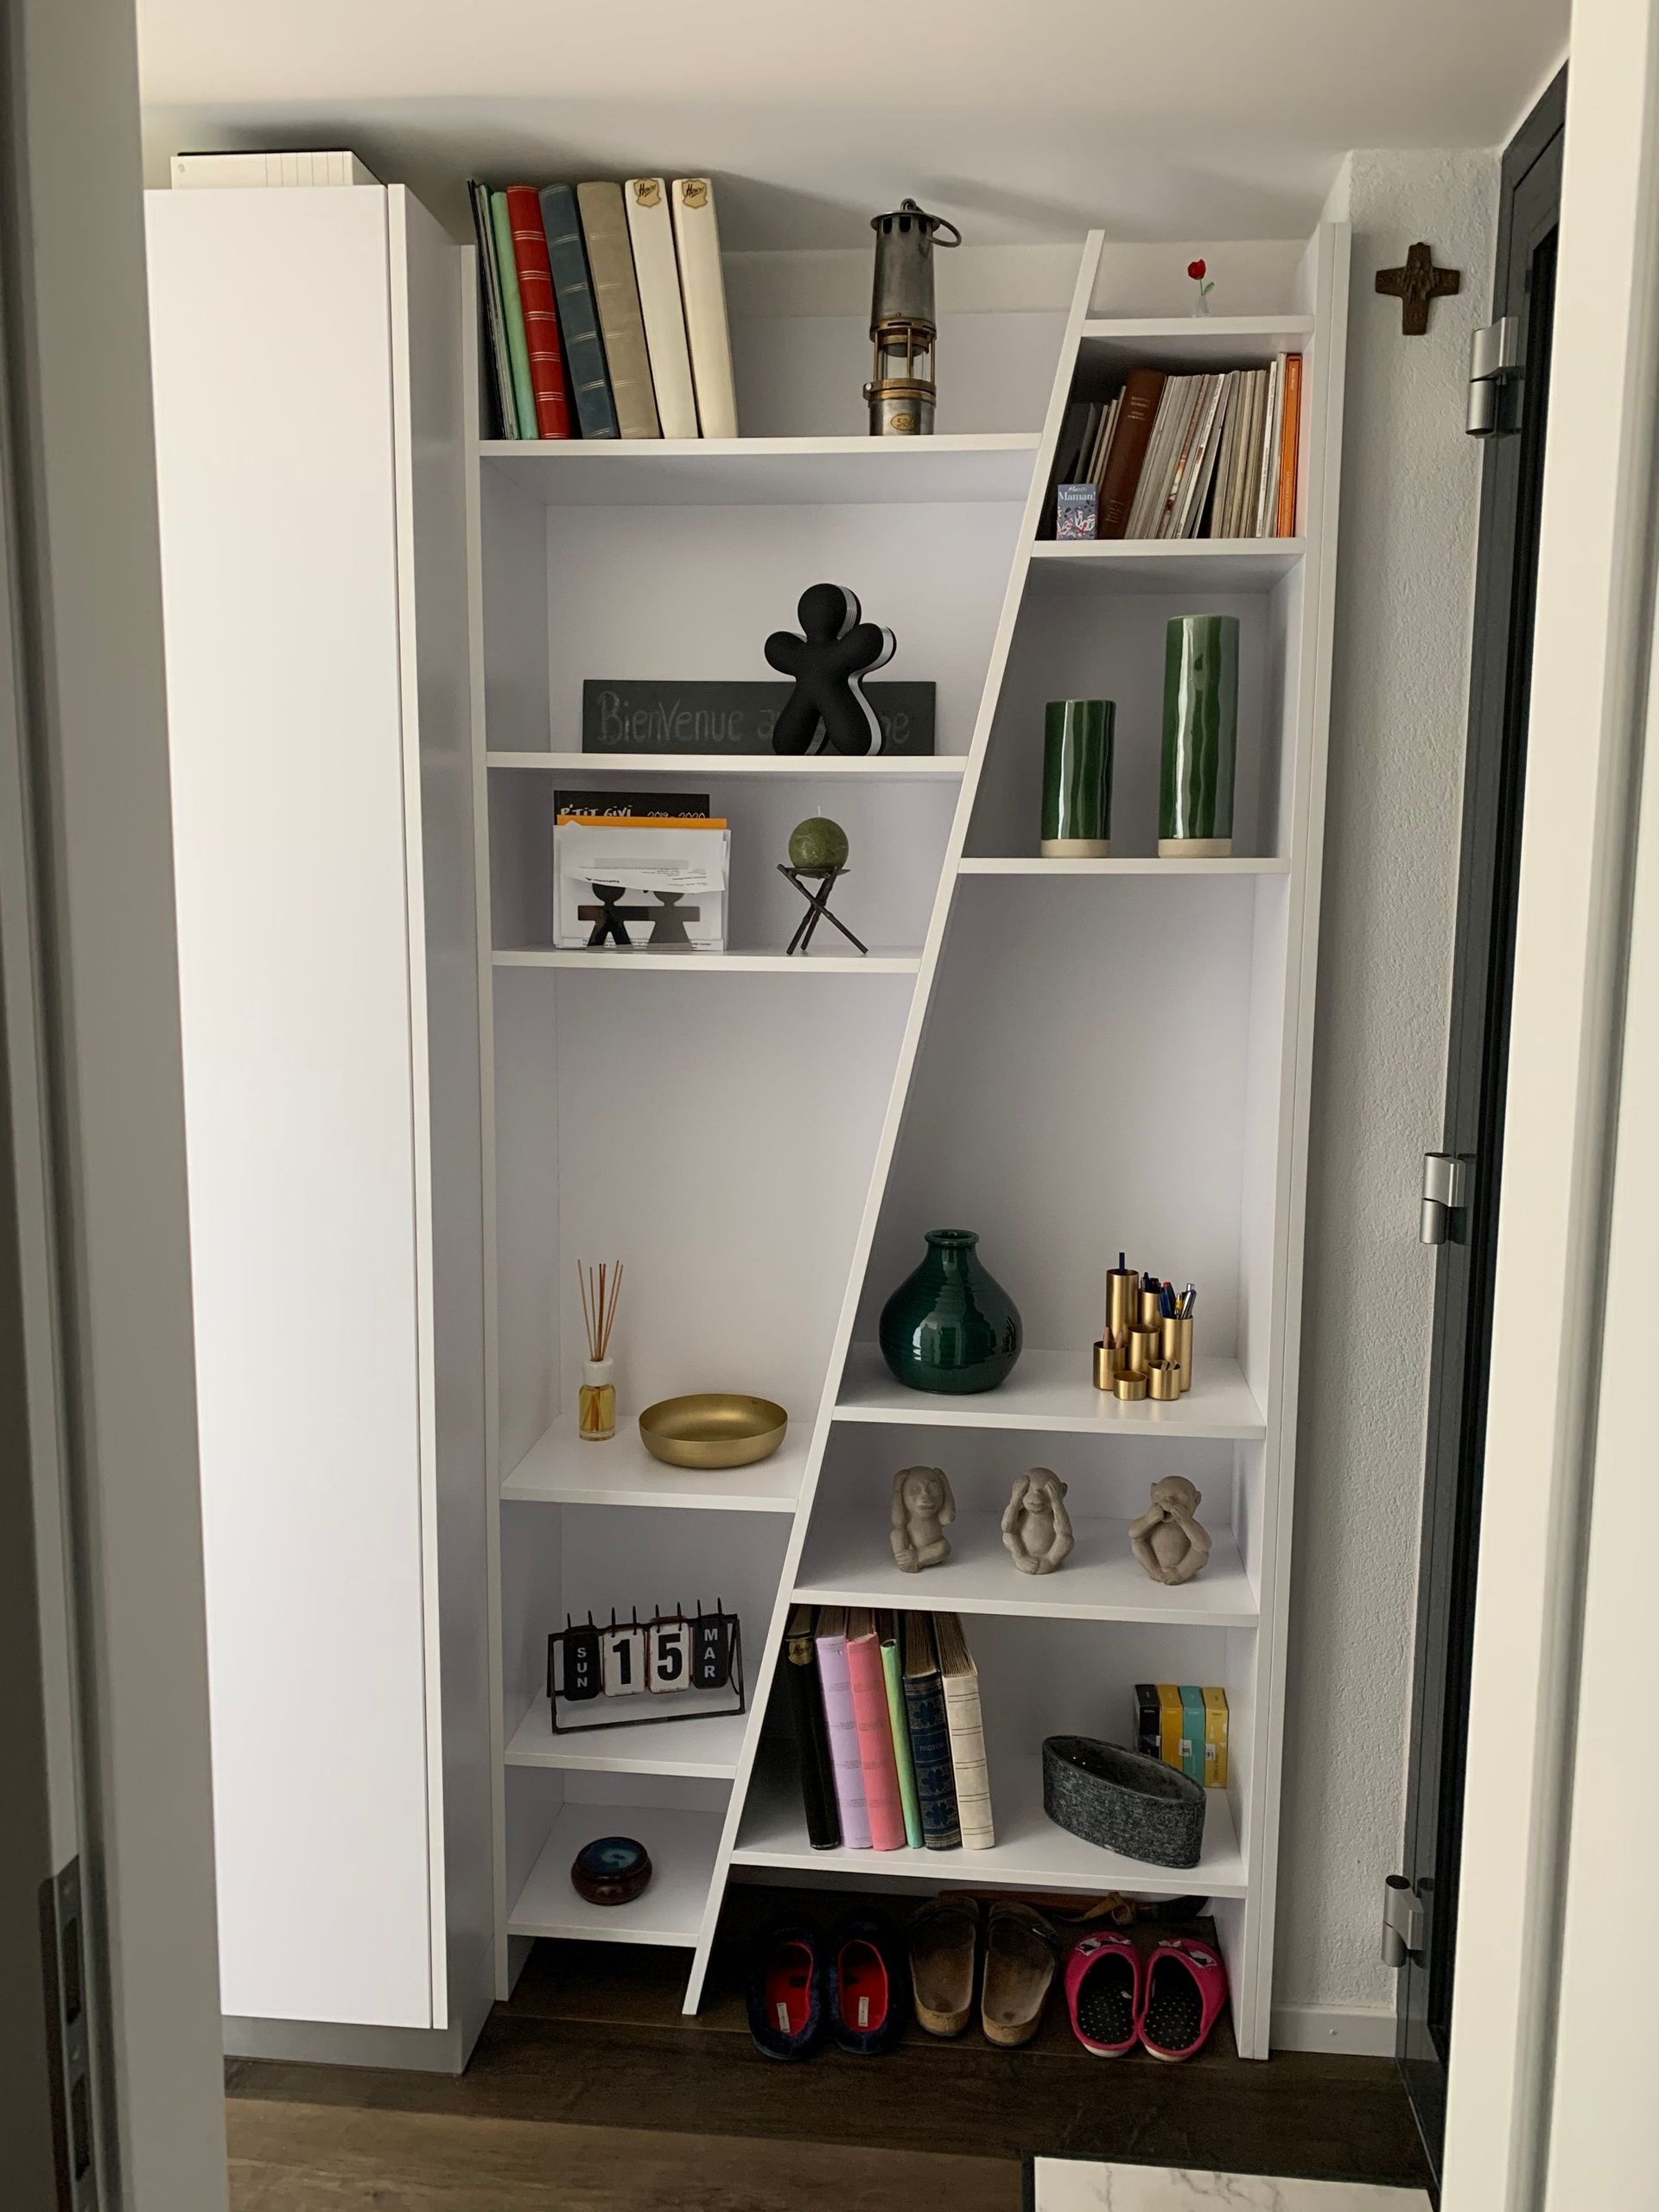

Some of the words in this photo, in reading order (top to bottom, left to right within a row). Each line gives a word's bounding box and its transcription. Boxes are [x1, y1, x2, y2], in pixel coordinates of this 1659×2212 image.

[1058, 491, 1096, 501] Maman!
[576, 1647, 588, 1688] SUN
[703, 1628, 719, 1679] MAR
